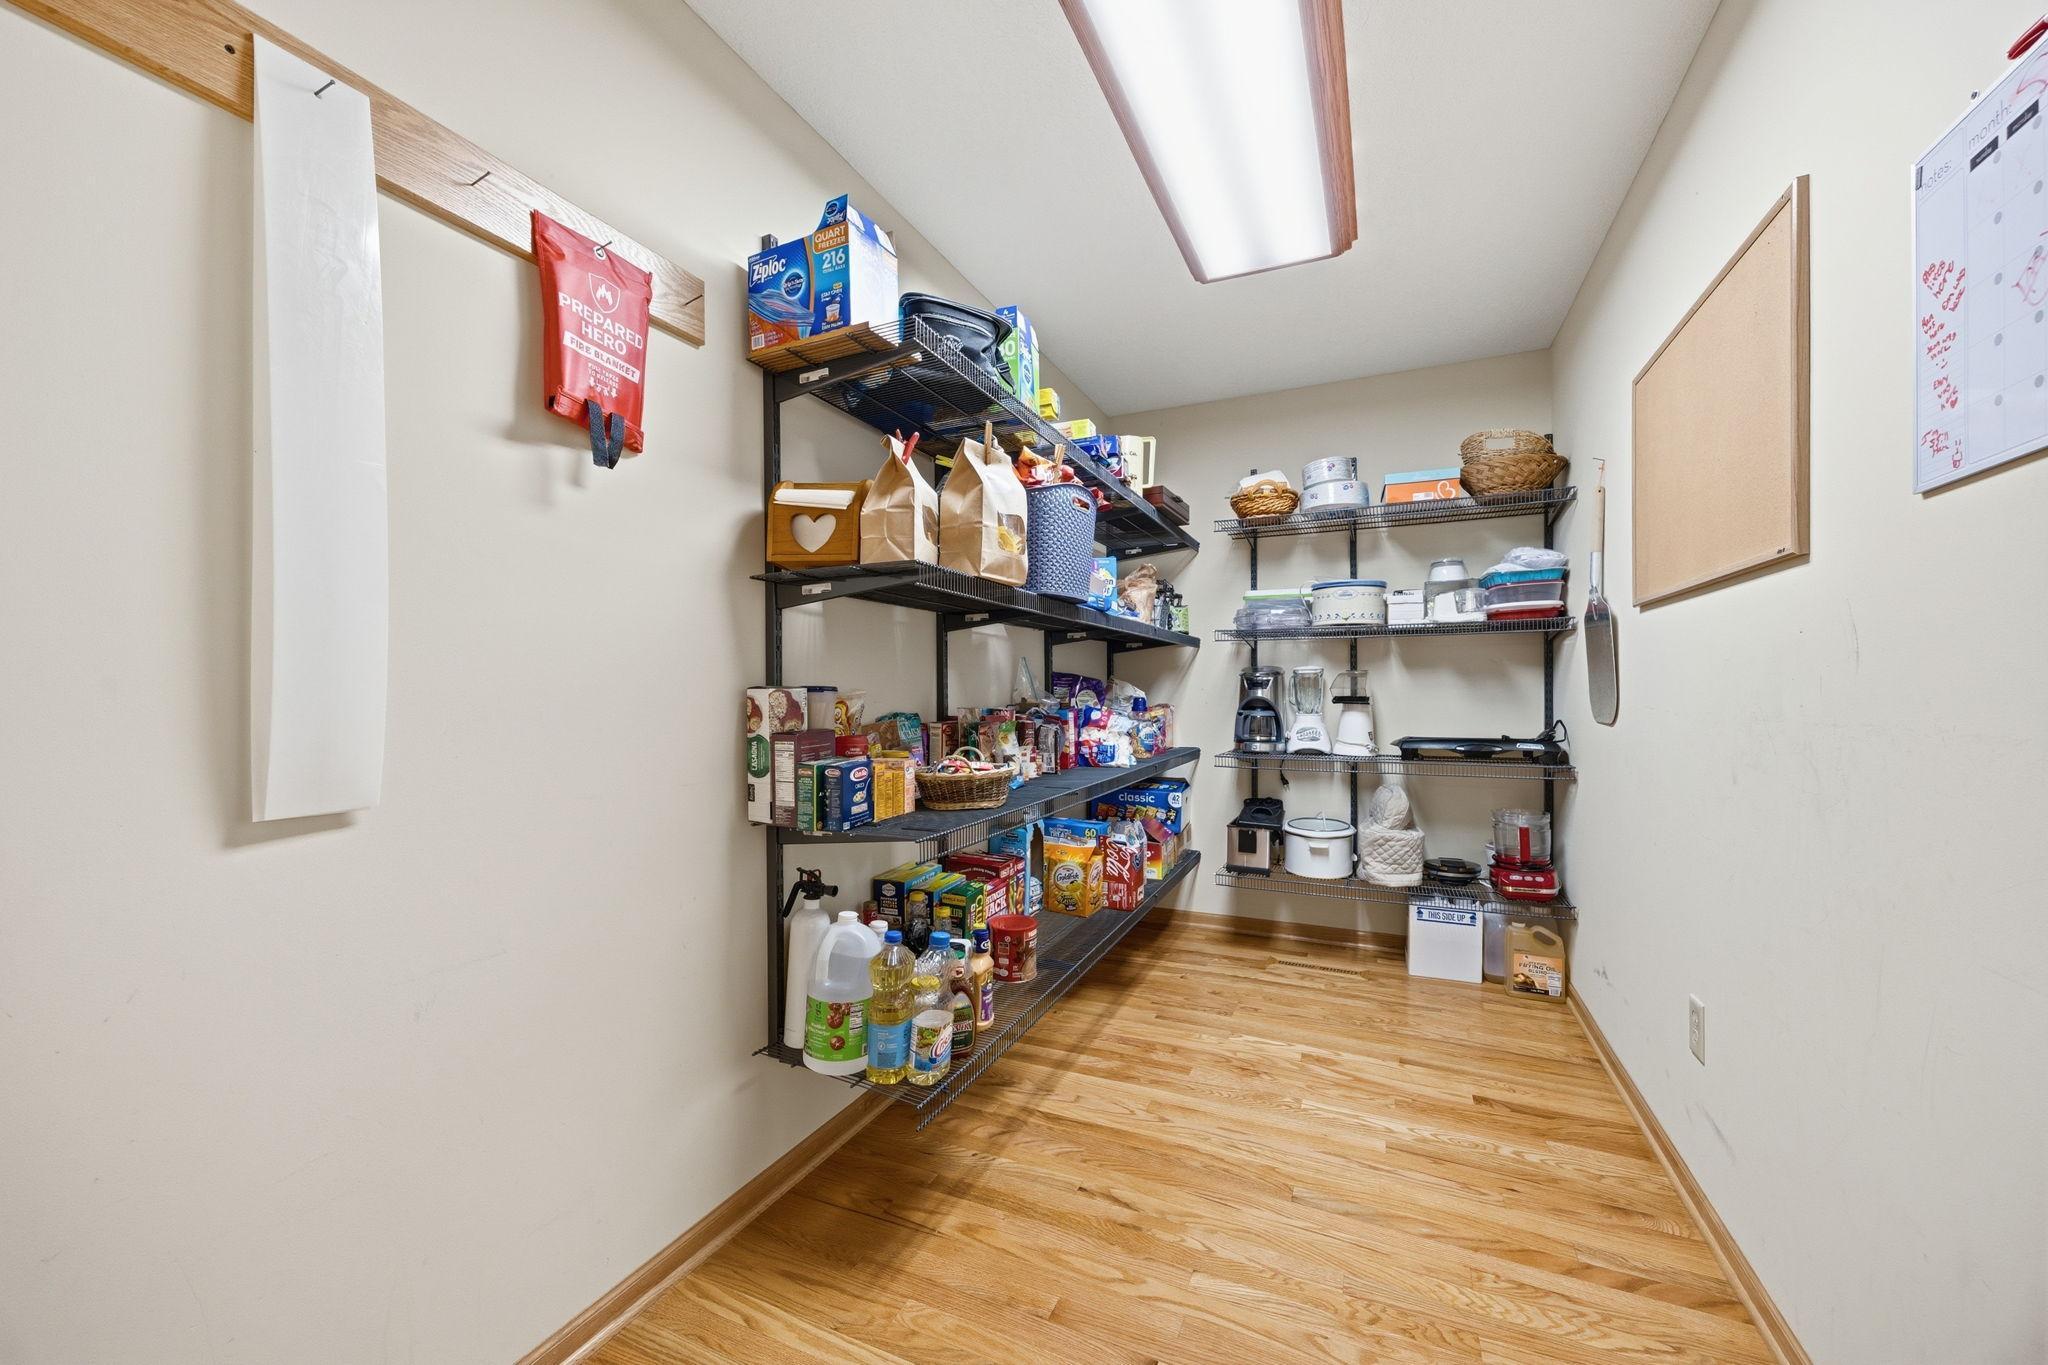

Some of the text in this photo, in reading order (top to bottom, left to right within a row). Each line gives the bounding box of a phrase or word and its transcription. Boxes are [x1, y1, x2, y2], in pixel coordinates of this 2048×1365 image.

[1968, 100, 2012, 150] month:
[814, 225, 846, 243] QUART
[818, 236, 846, 250] FREEZER
[822, 248, 846, 270] 216
[752, 258, 787, 283] Ziploc
[558, 291, 643, 350] PREPARED
[581, 321, 627, 356] HERO
[569, 336, 637, 379] FIRE BLANKET
[1118, 792, 1156, 803] classic
[1084, 828, 1097, 837] 60
[1056, 864, 1080, 882] Goldfish
[1428, 911, 1466, 922] THIS SIDE UP
